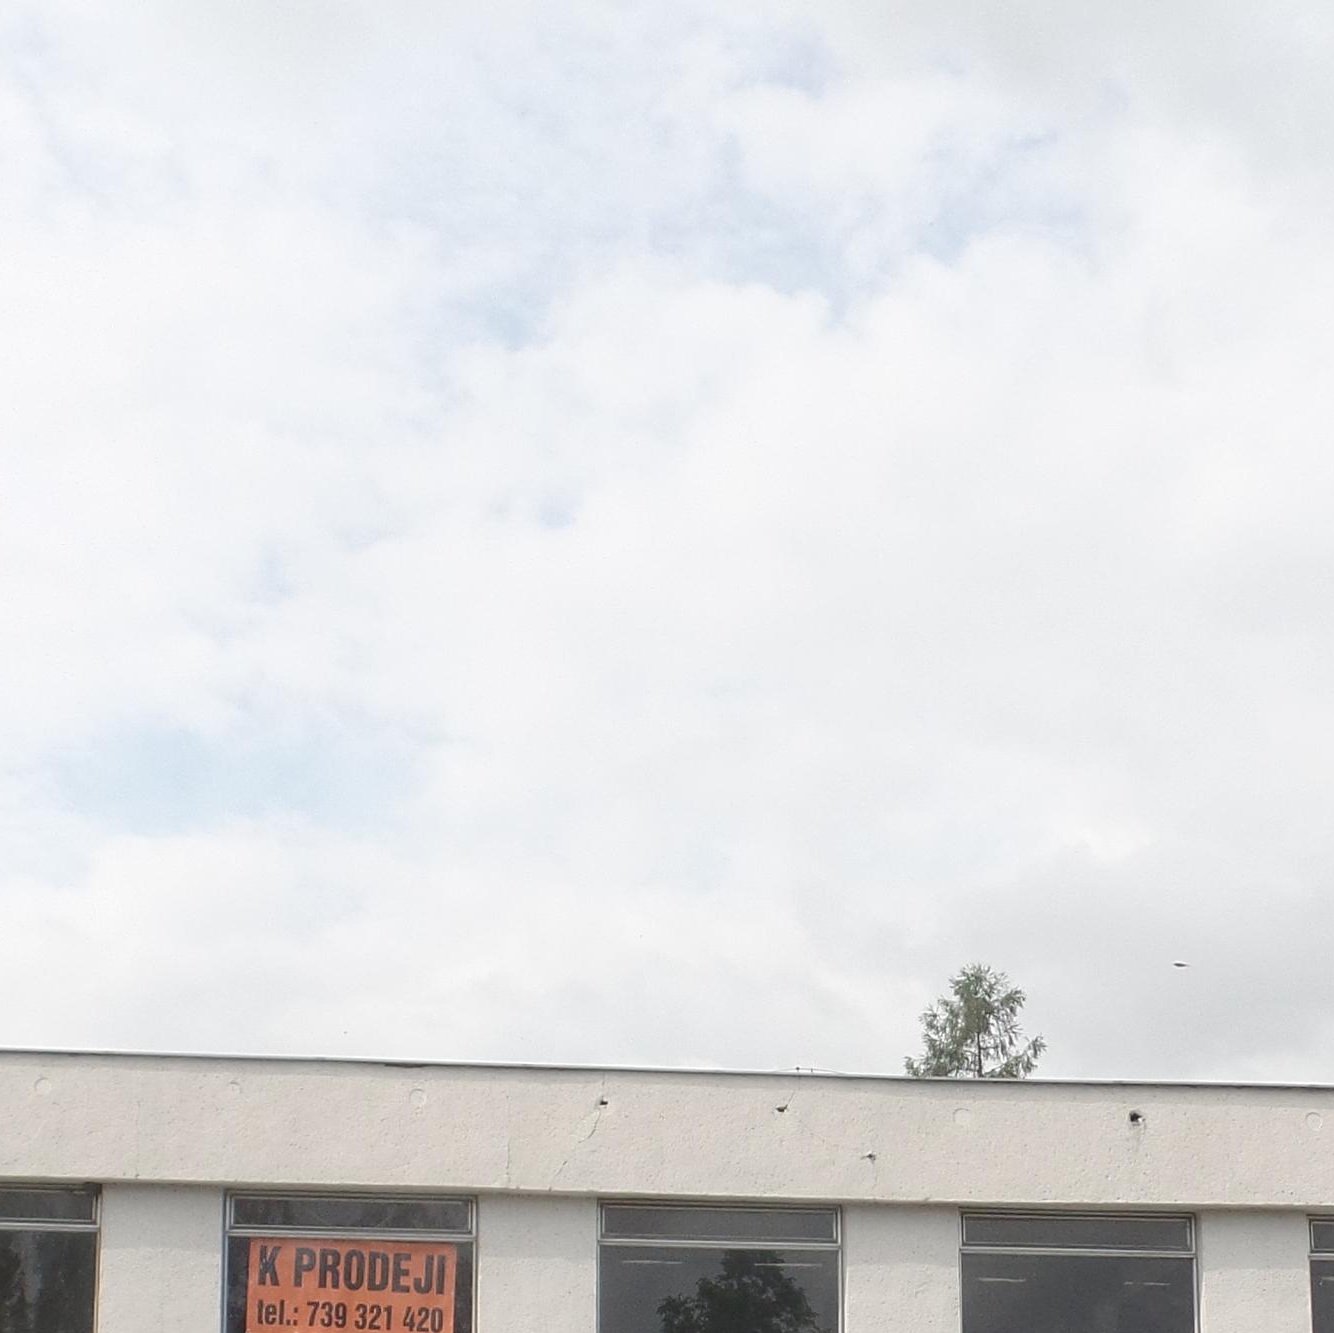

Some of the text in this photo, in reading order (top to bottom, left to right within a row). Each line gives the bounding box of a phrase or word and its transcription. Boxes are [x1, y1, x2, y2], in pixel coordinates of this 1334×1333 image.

[258, 1245, 447, 1295] K PRODEJI
[257, 1299, 444, 1333] tel.: 739 321 420
